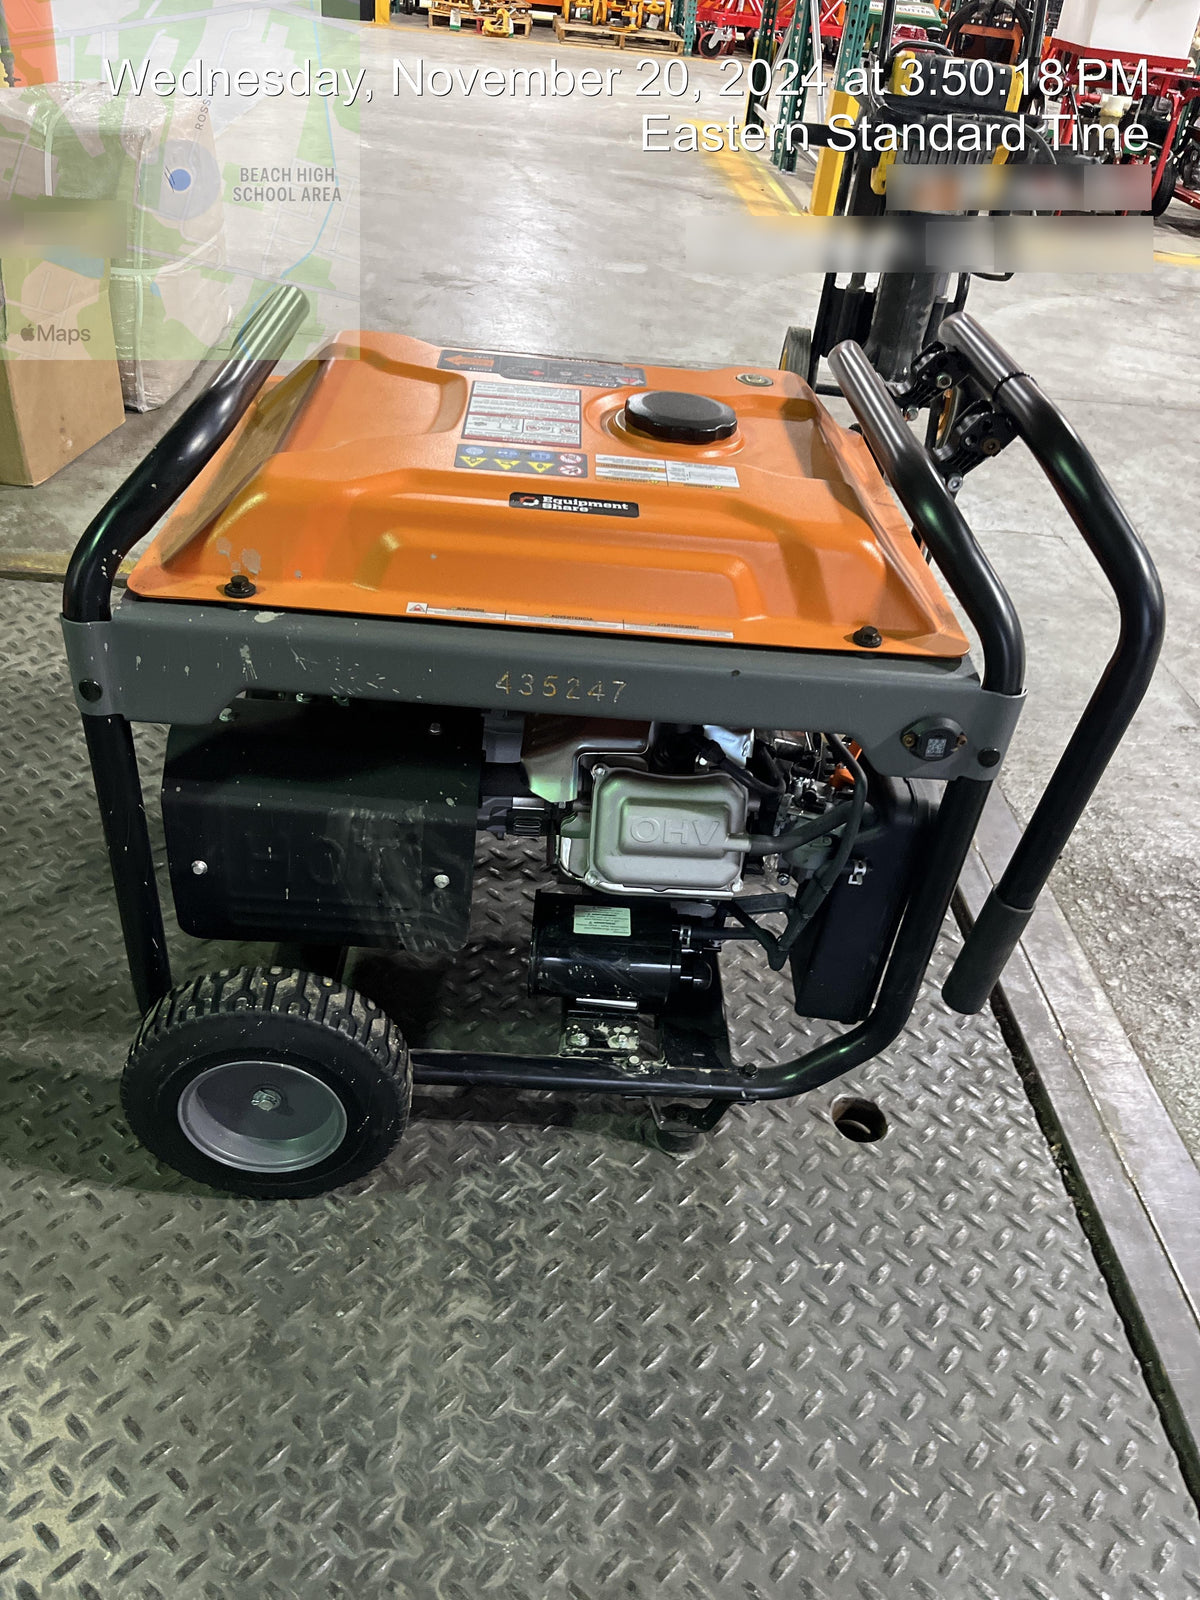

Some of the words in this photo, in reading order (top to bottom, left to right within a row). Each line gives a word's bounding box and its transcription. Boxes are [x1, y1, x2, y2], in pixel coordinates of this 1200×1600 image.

[542, 496, 629, 510] Equipment
[542, 502, 589, 512] Share
[495, 671, 627, 703] 435247
[630, 817, 720, 846] OHV
